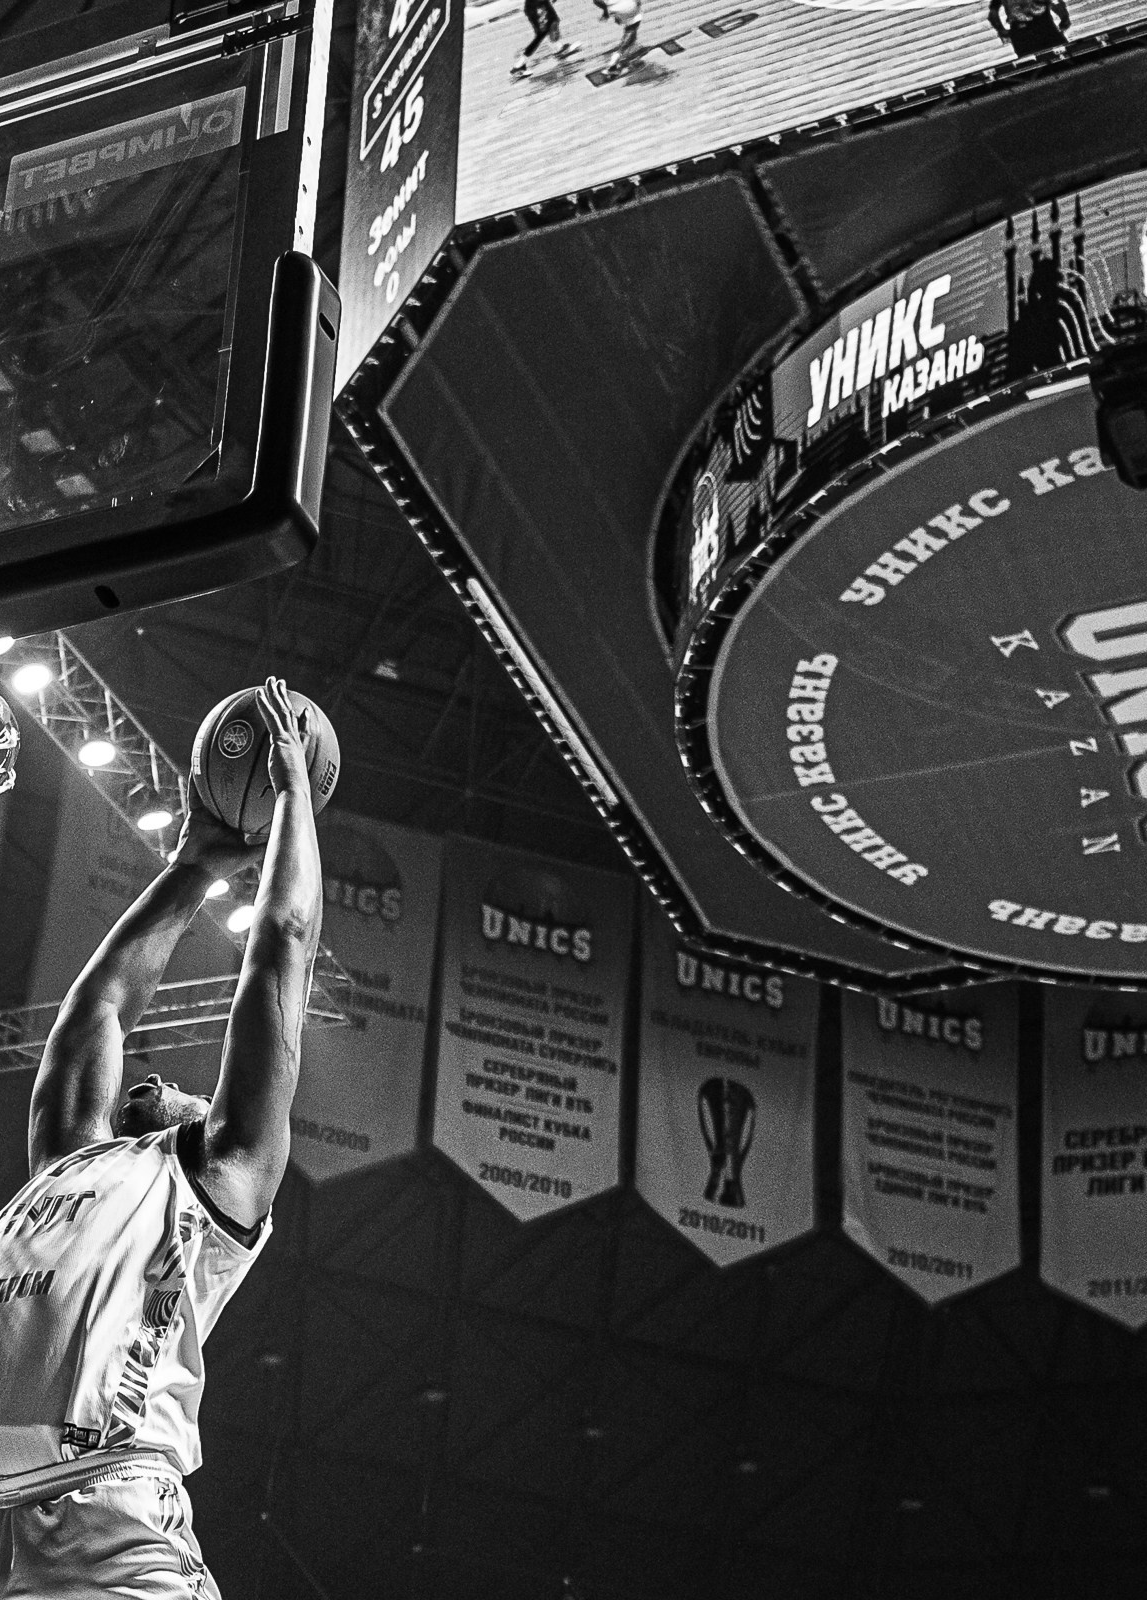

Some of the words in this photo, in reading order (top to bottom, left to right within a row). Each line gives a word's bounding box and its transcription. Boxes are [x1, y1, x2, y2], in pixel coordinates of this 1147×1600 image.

[380, 75, 424, 173] 45
[807, 274, 951, 428] УНИКС
[882, 335, 985, 418] КАЗАНЬ
[480, 904, 592, 962] UNICS
[677, 951, 784, 1009] UNICS
[878, 998, 983, 1050] UNICS
[678, 1207, 766, 1244] 2010/2011
